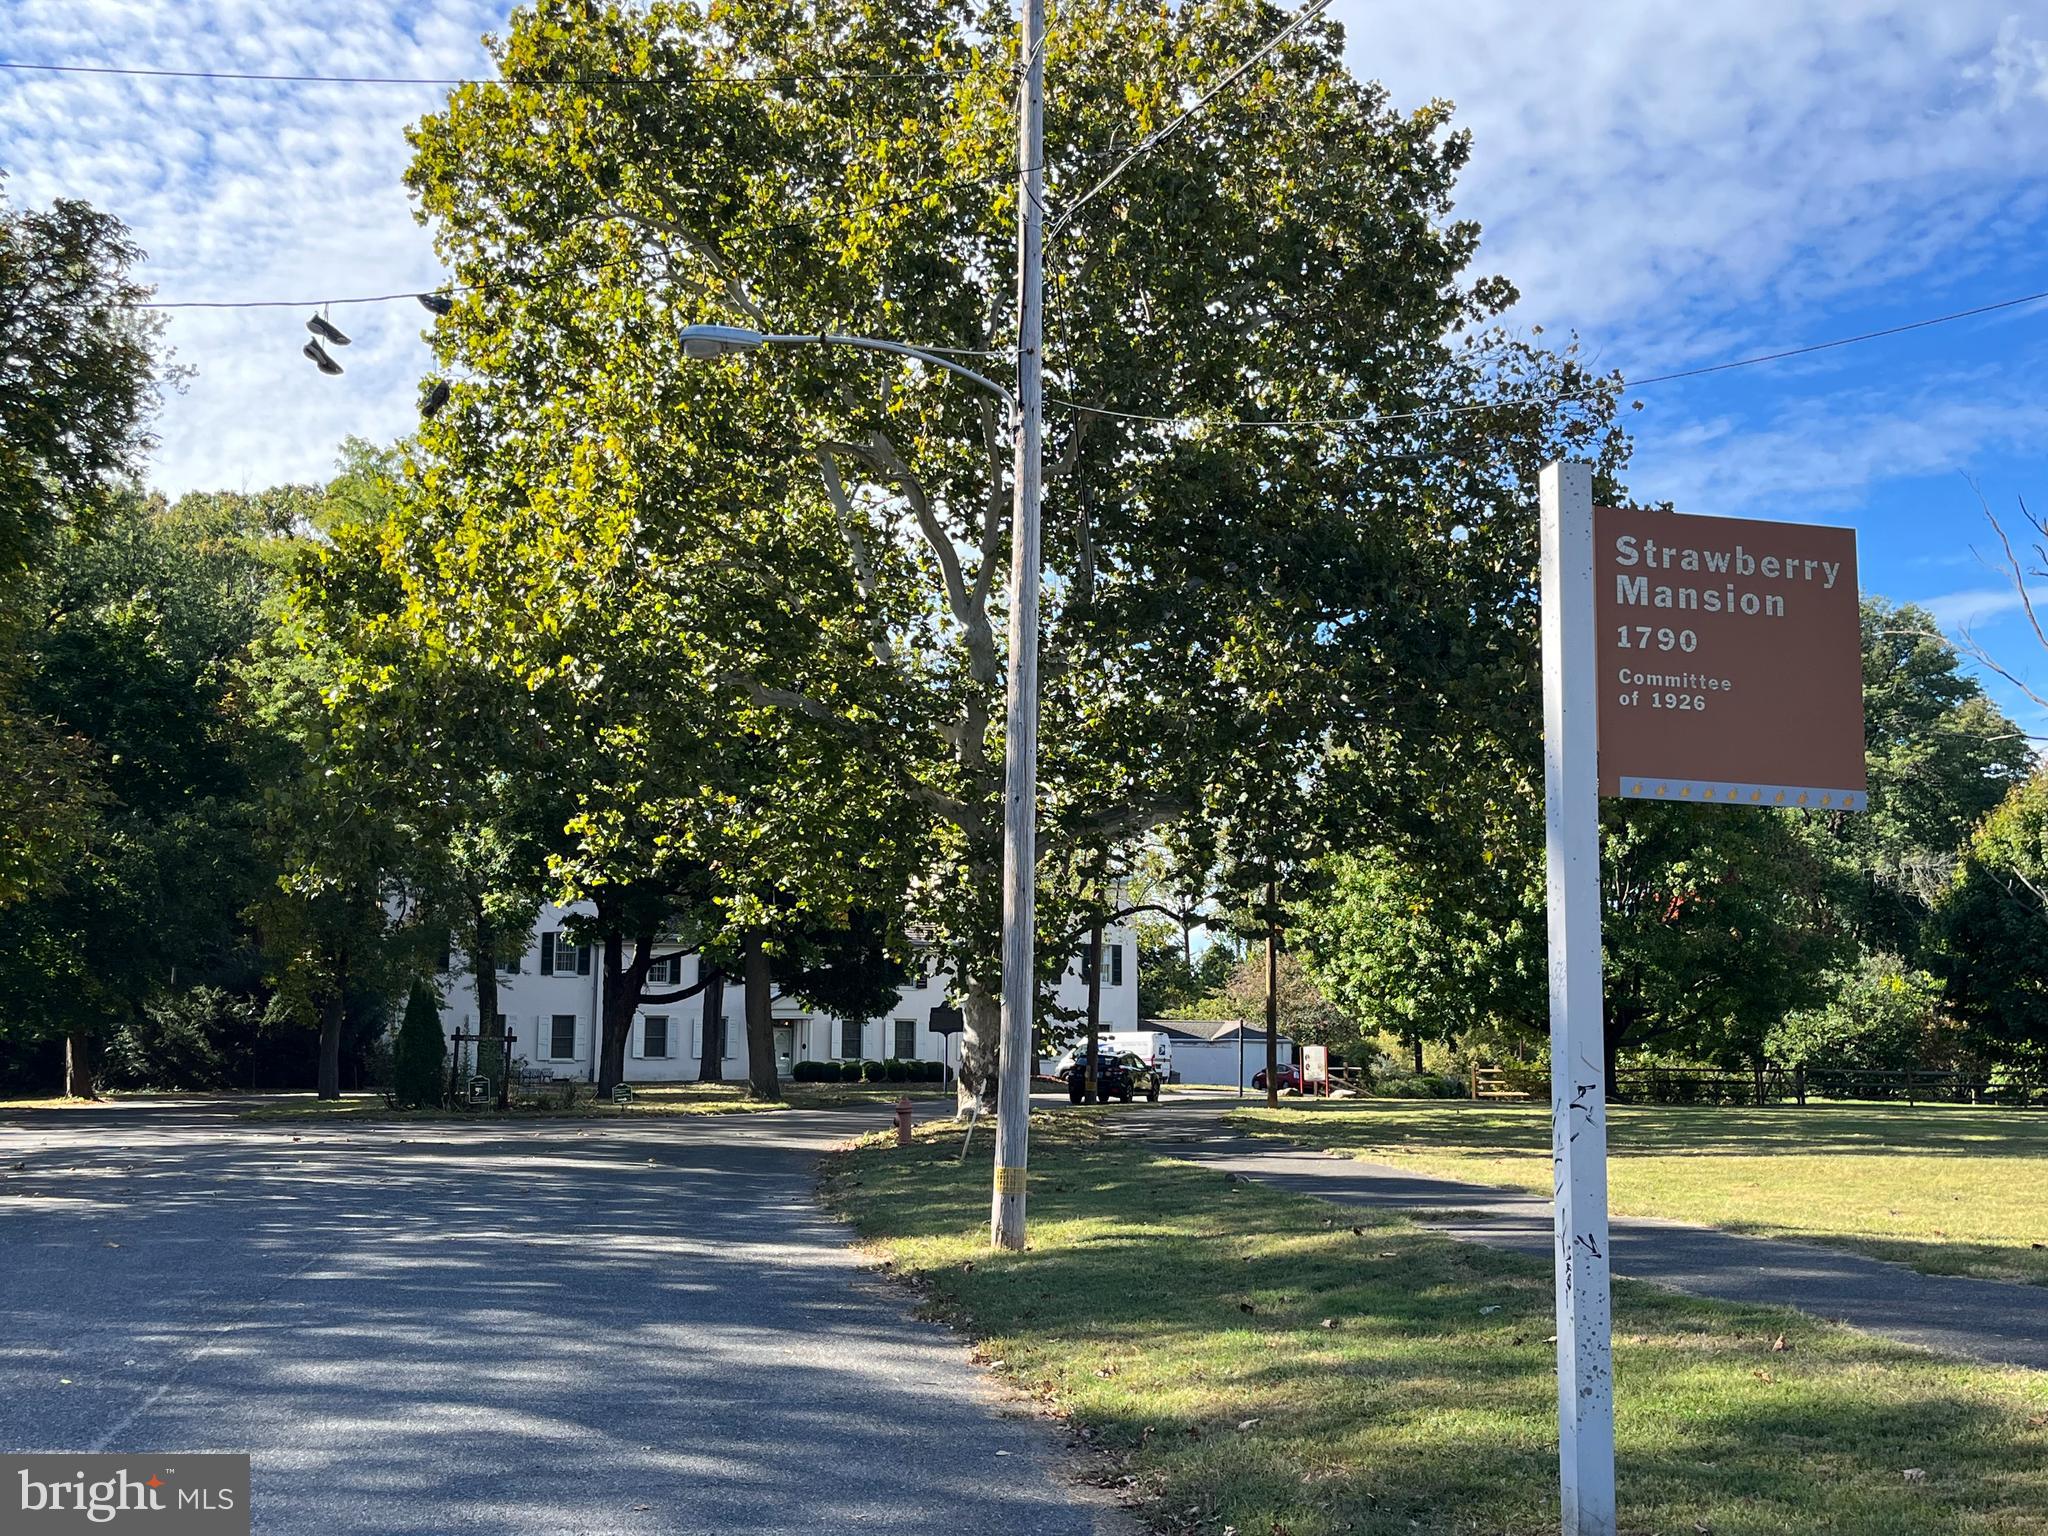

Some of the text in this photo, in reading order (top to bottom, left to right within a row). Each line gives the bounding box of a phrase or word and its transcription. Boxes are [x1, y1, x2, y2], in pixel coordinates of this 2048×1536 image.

[1615, 535, 1840, 589] Strawberry
[1616, 574, 1785, 617] Mansion
[1617, 625, 1698, 653] 1790
[1618, 668, 1732, 691] Committee
[1619, 691, 1706, 711] of 1926
